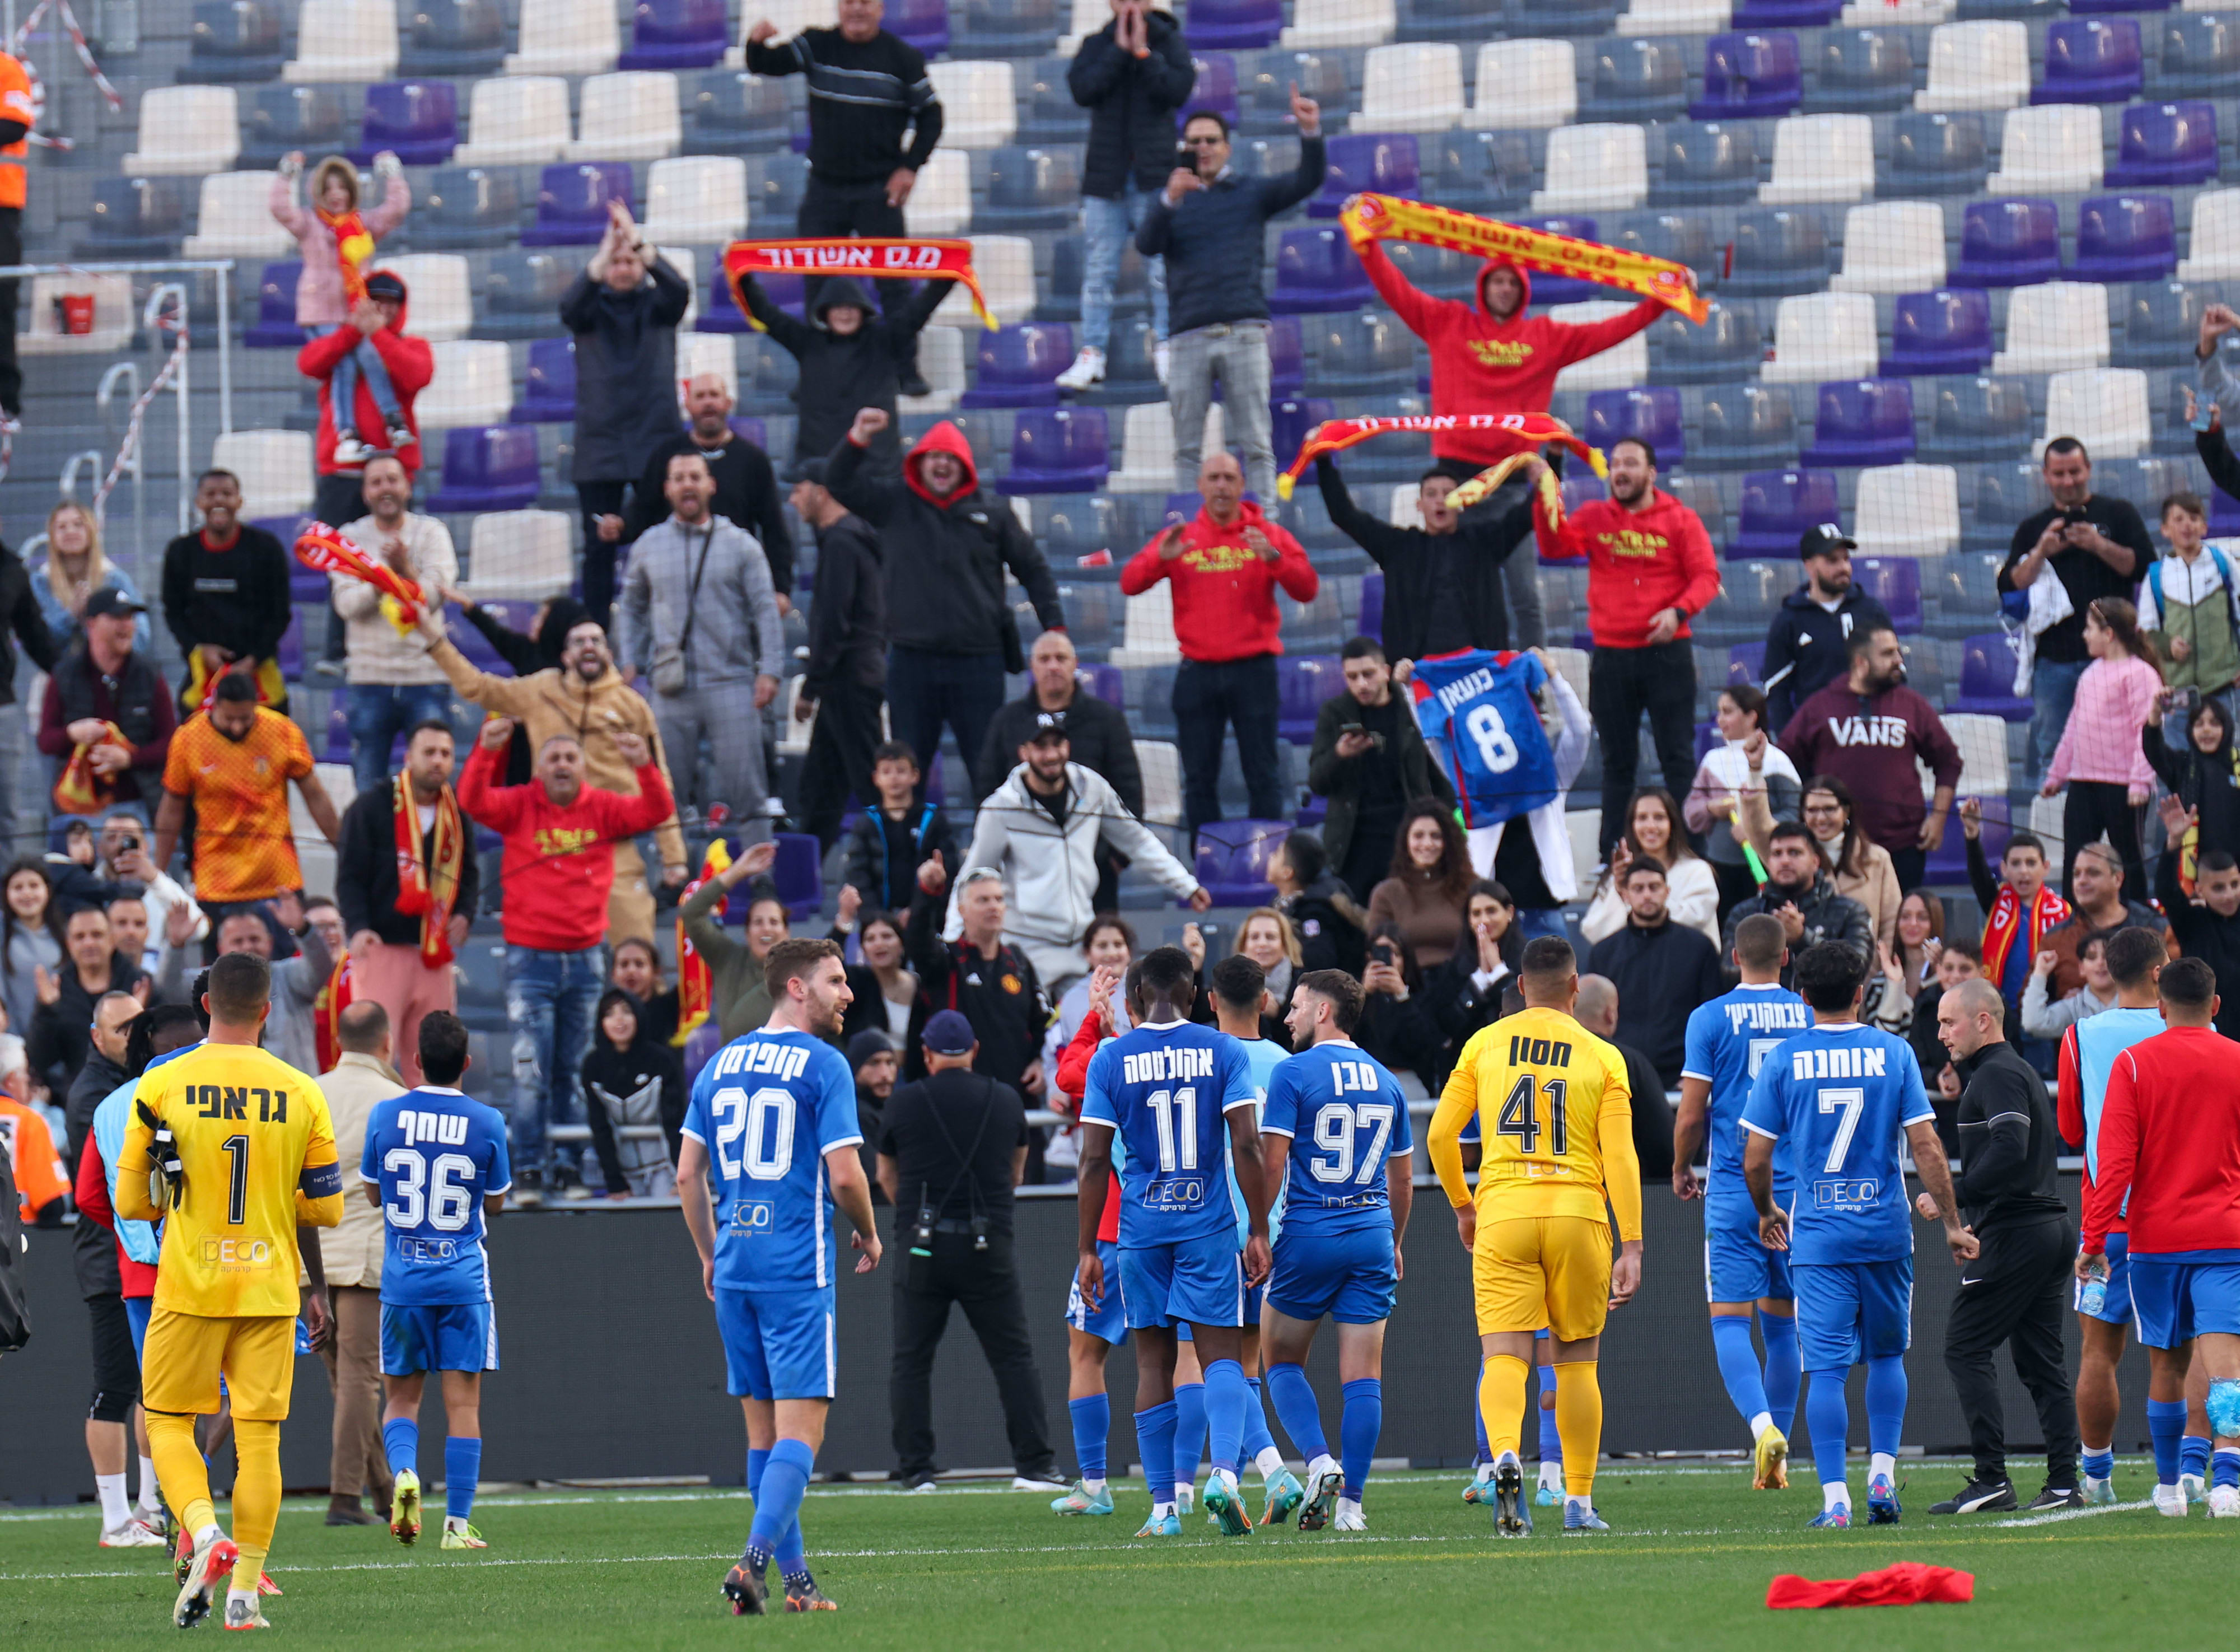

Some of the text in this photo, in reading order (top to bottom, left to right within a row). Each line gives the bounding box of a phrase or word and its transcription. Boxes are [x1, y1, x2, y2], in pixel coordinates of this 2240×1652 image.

[757, 246, 942, 269] מ.ס אשדוד
[1468, 414, 1527, 430] מס
[1438, 667, 1495, 716] כנעאן
[1466, 703, 1519, 774] 8
[1828, 715, 1908, 749] VANS
[713, 1042, 811, 1082] קופרמן
[1123, 1045, 1214, 1085] אקולטסה
[1509, 1035, 1572, 1068] חסון
[1793, 1047, 1887, 1081] אוחנה
[1331, 1061, 1379, 1096] סבן
[186, 1084, 287, 1124] גראפי
[1497, 1074, 1567, 1156] 41
[397, 1109, 469, 1146] שחף
[712, 1086, 797, 1181] 20
[1146, 1086, 1197, 1172] 11
[1310, 1103, 1394, 1184] 97
[1818, 1087, 1864, 1173] 7
[221, 1134, 250, 1225] 1
[384, 1147, 476, 1231] 36
[1150, 1182, 1201, 1203] DECO
[1819, 1182, 1875, 1203] DECO
[731, 1204, 769, 1227] ECO
[204, 1239, 269, 1263] DECO
[401, 1240, 452, 1259] DECO
[221, 1265, 251, 1273] קרמיקה
